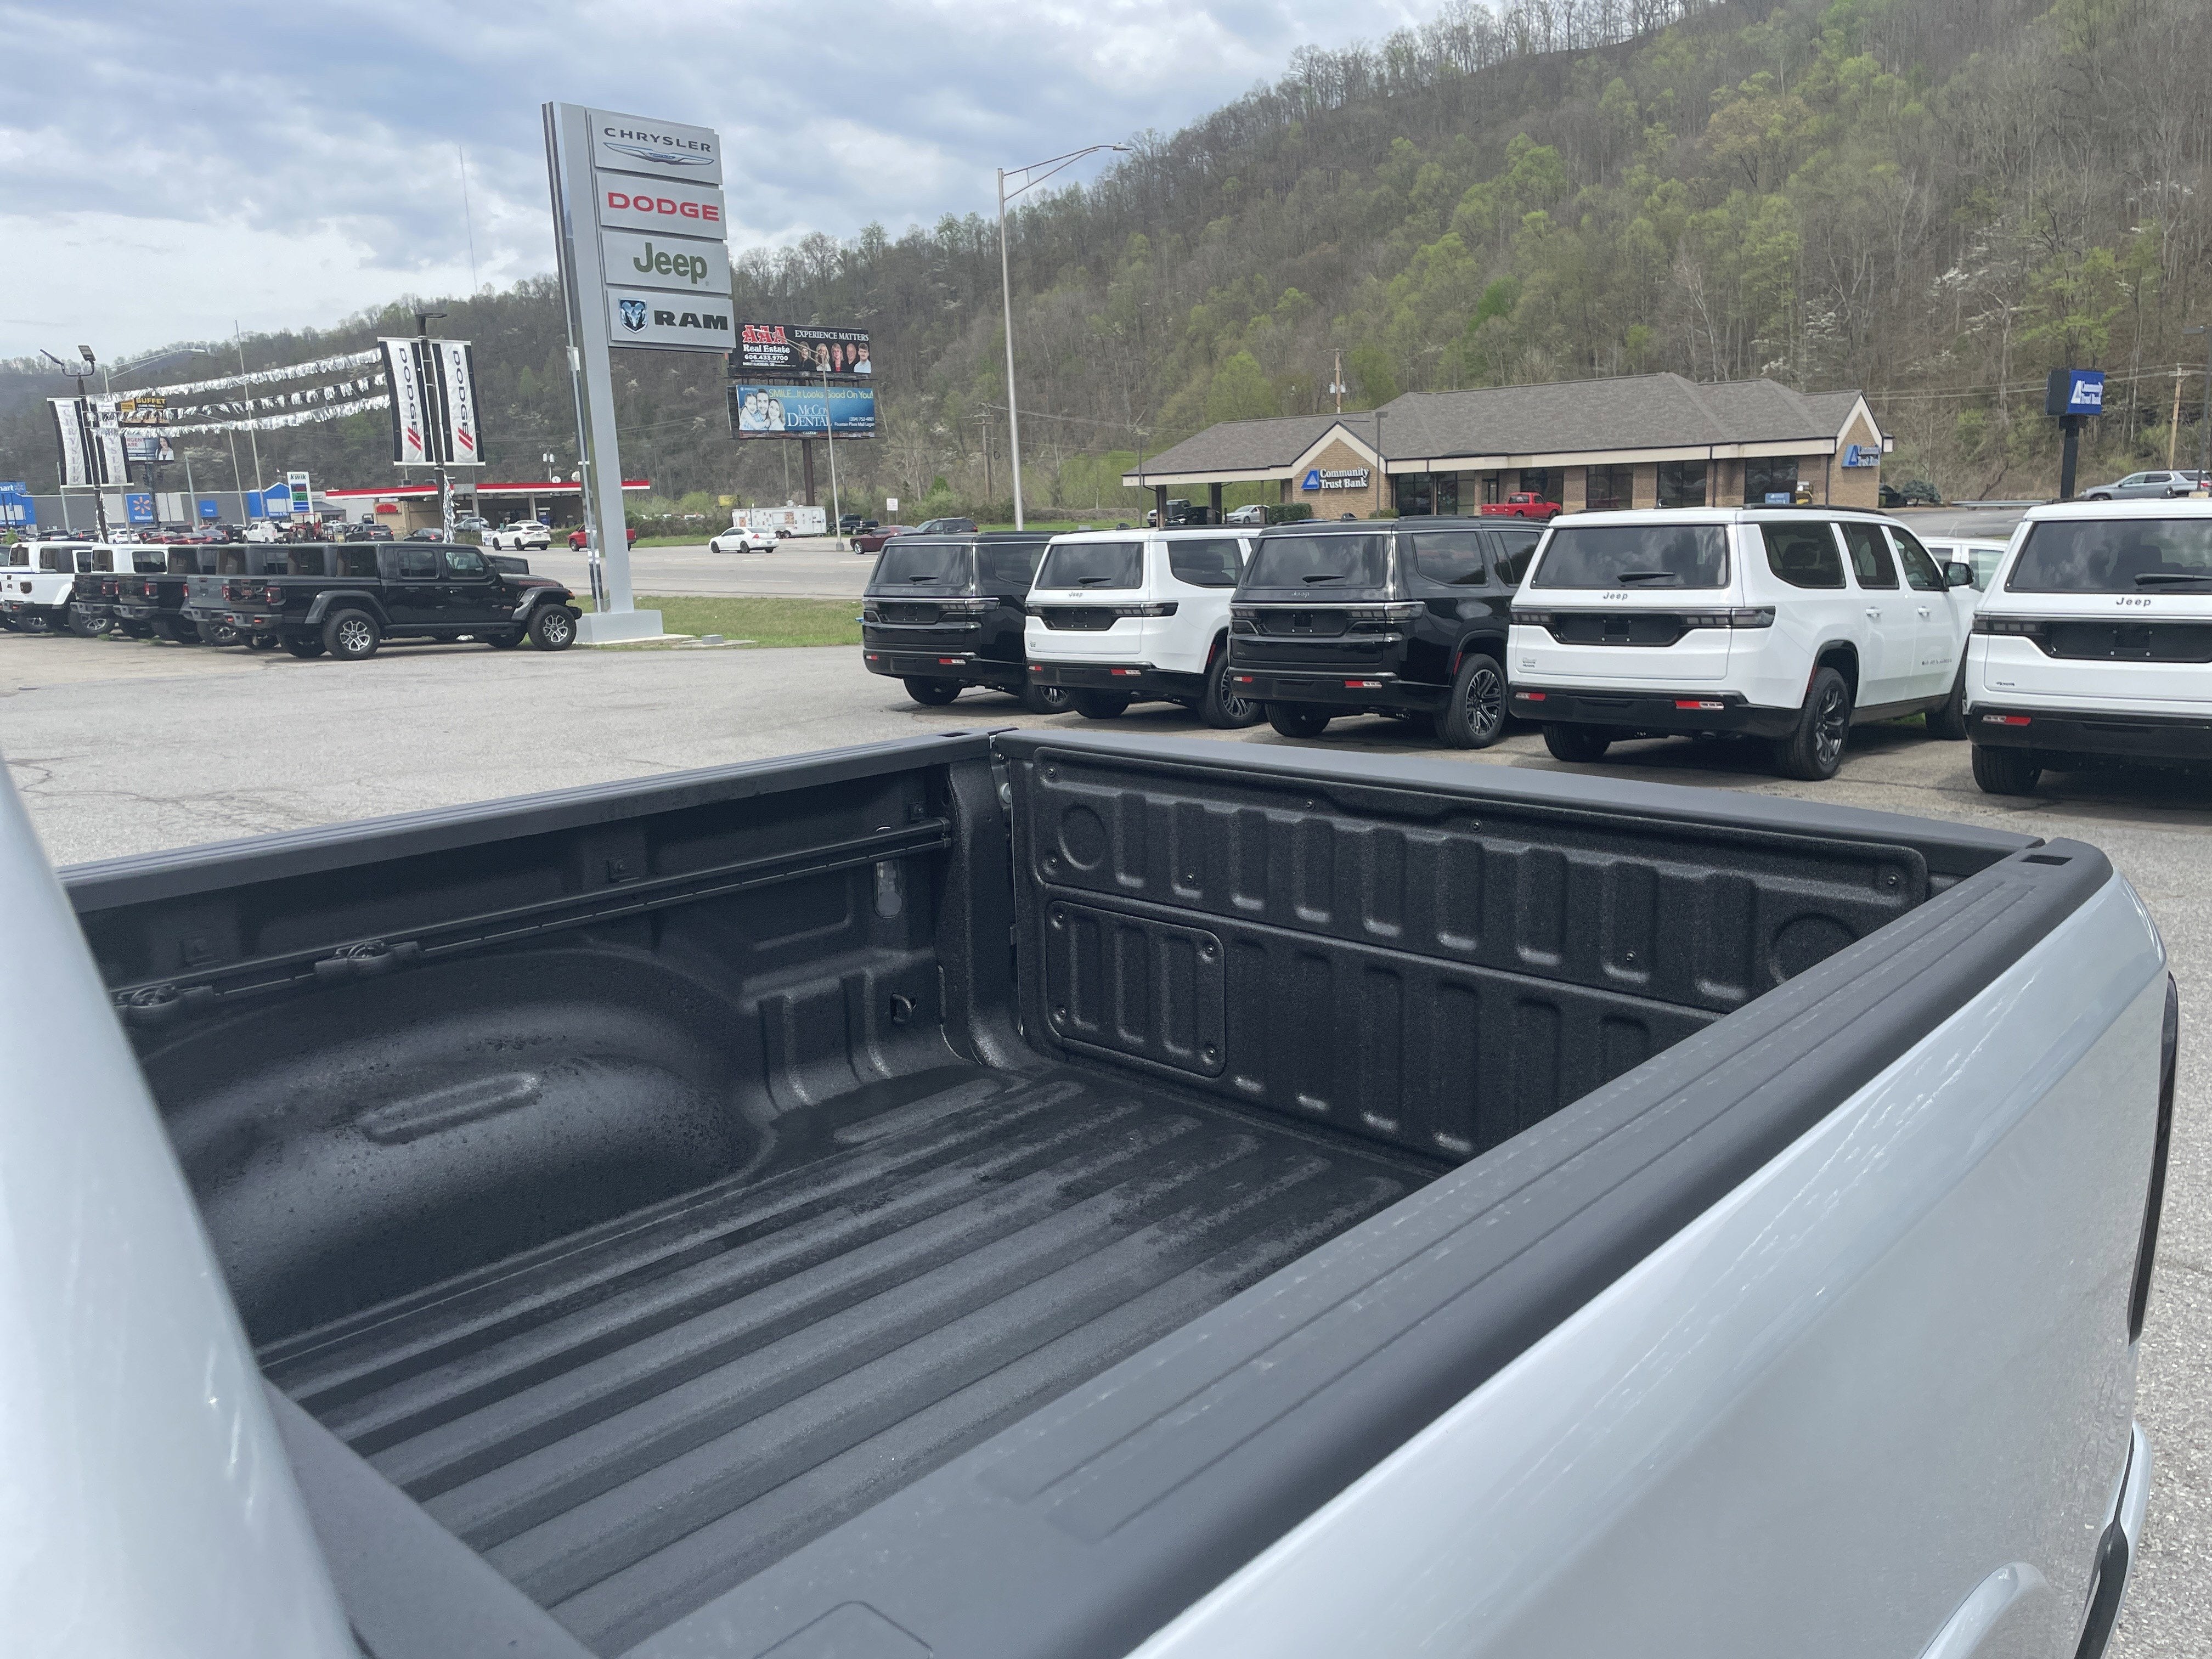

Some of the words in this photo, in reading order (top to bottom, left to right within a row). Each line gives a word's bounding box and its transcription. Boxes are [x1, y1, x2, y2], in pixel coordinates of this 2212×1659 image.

[604, 127, 711, 153] CHRYSLER
[608, 192, 720, 222] DODGE
[633, 242, 707, 284] Jeep
[654, 310, 728, 330] RAM
[742, 325, 788, 345] AAA
[794, 330, 837, 340] EXPERIENCE
[838, 332, 869, 341] MATTERS
[743, 344, 762, 352] Real
[763, 345, 790, 353] Estate
[399, 348, 417, 436] DODGE
[453, 351, 469, 436] DODGE
[803, 390, 823, 398] Looks
[847, 390, 858, 399] On
[859, 390, 873, 399] You!
[1319, 466, 1369, 478] Community
[1319, 479, 1342, 489] Trust
[1343, 477, 1368, 488] Bank
[1603, 592, 1628, 601] Jeep
[2115, 597, 2152, 608] Jeep
